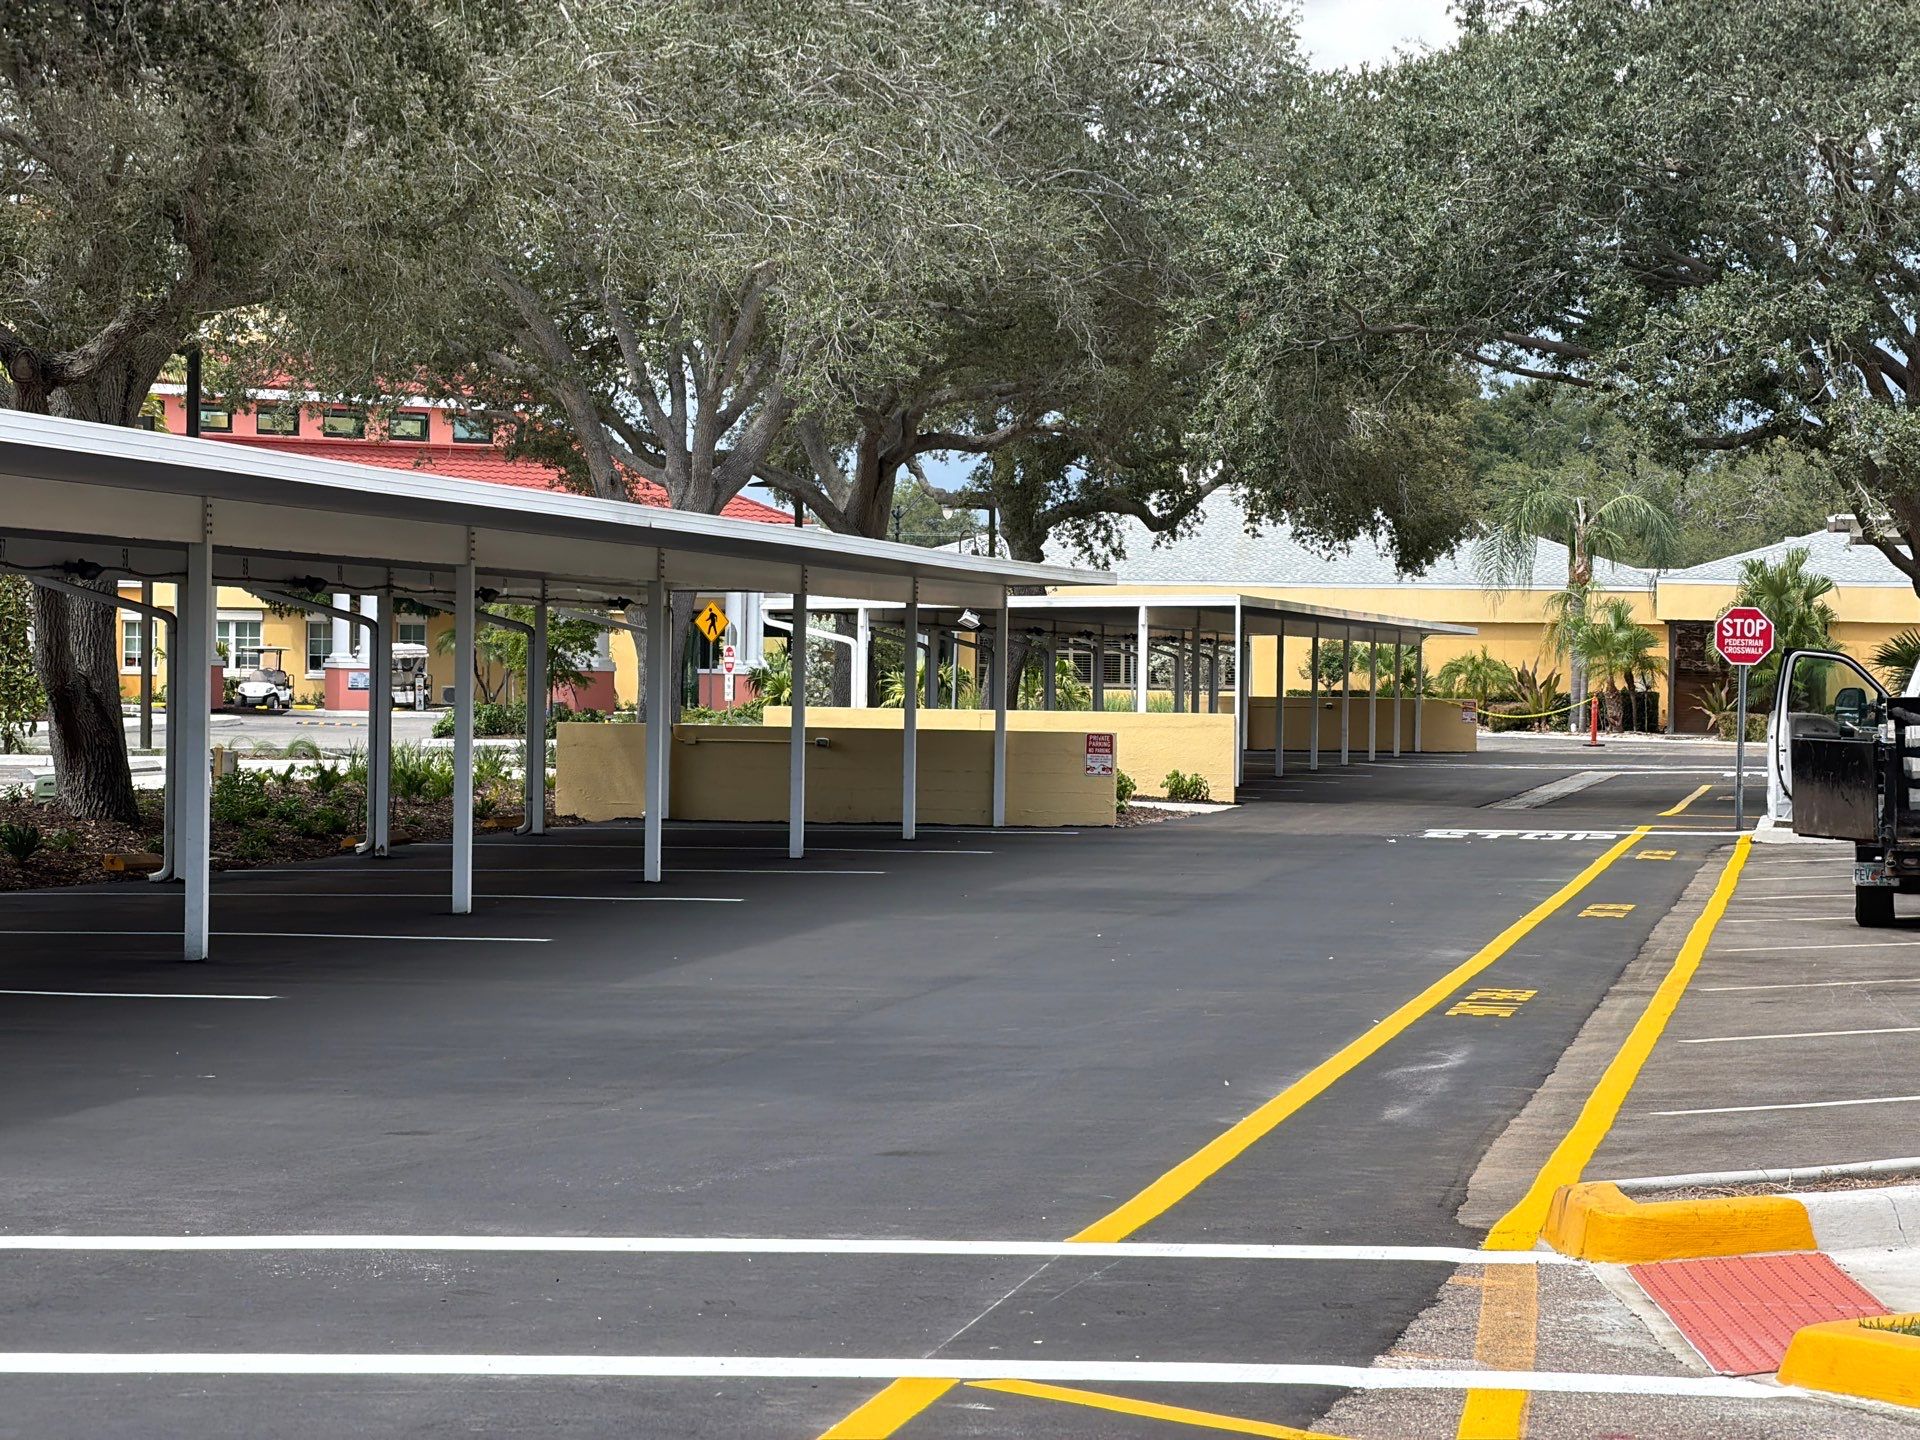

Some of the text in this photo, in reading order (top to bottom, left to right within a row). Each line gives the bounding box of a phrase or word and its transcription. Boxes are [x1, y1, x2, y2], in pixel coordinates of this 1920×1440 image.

[1722, 618, 1767, 637] STOP
[1724, 638, 1764, 647] PEDESTRIAN
[1724, 647, 1763, 655] CROSSWALK
[1422, 831, 1617, 841] STOP
[1855, 868, 1870, 881] FEV
